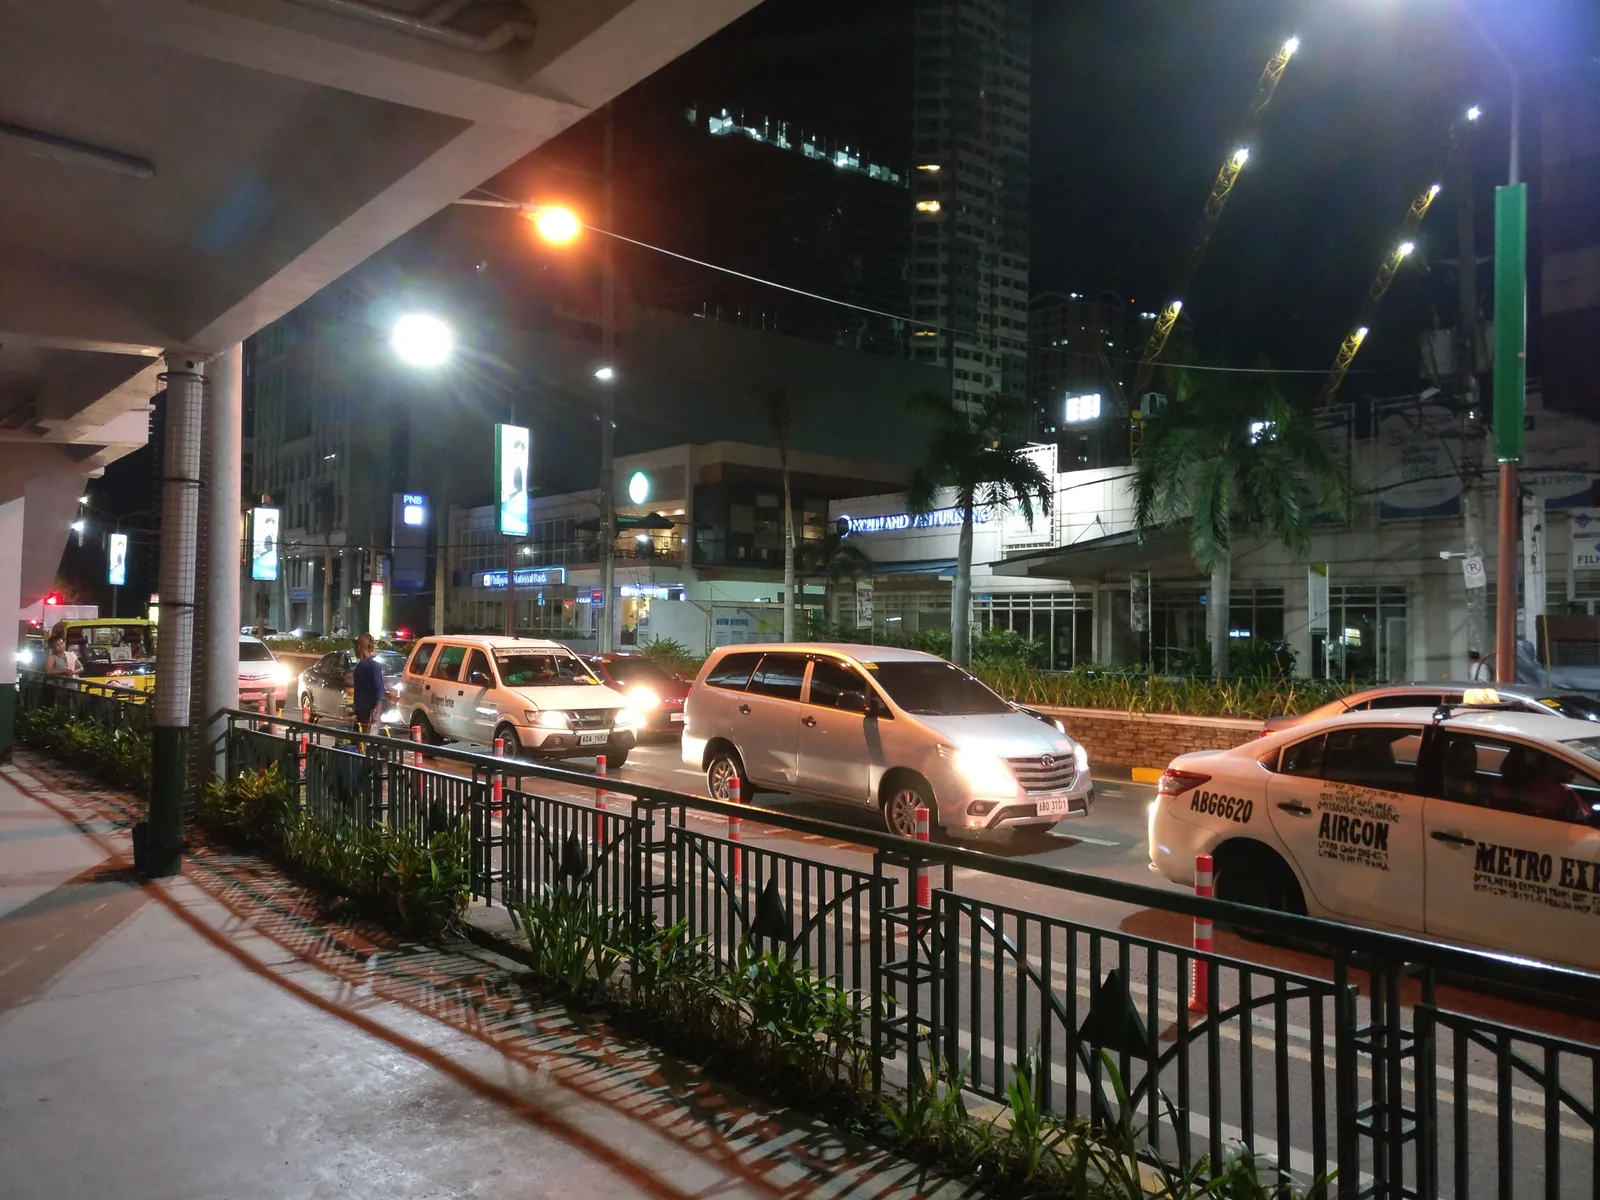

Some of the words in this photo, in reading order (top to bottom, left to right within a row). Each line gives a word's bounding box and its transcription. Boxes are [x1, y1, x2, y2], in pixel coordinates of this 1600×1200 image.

[403, 494, 423, 505] PNB
[715, 617, 729, 626] NOW
[730, 618, 749, 627] HIRING
[1190, 789, 1253, 824] ABG6620
[1318, 811, 1389, 851] AIRCON
[1475, 841, 1553, 883] METRO
